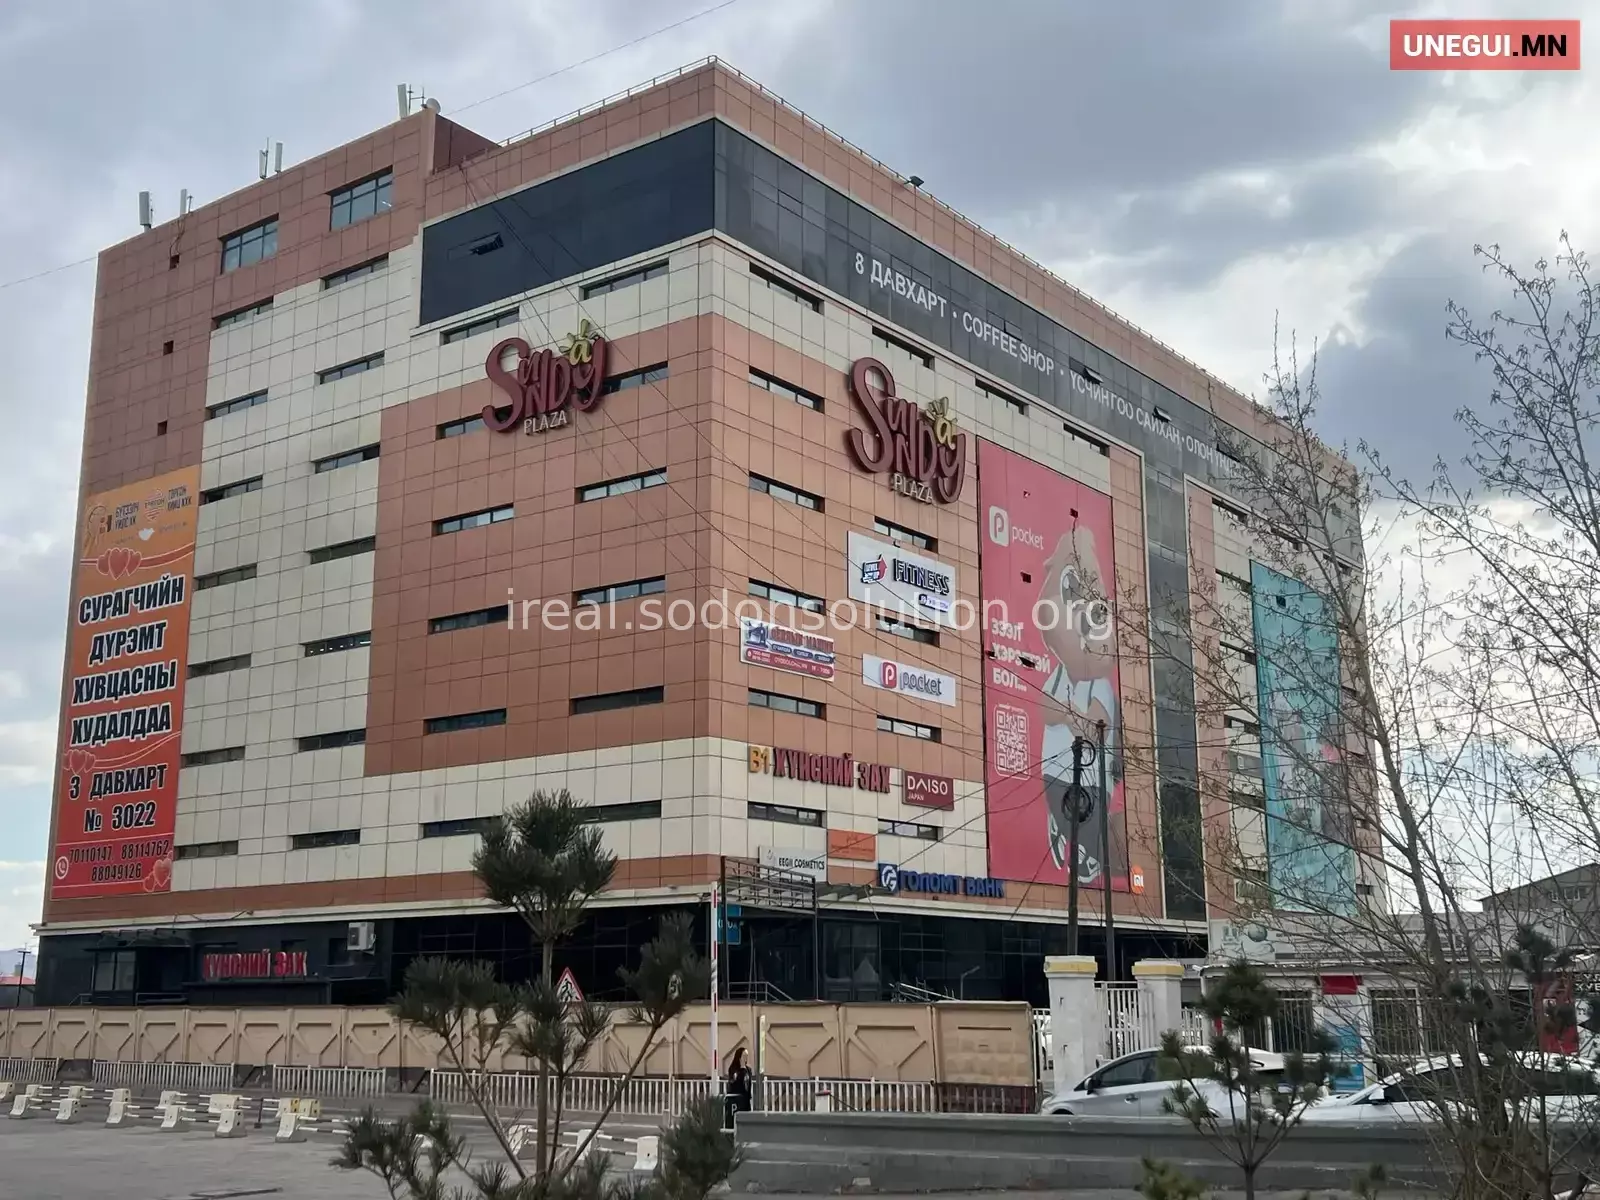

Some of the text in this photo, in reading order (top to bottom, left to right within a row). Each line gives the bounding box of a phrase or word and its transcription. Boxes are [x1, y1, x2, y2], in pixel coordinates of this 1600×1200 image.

[855, 252, 865, 275] 8
[870, 259, 947, 318] ДАВХАРТ
[963, 311, 1018, 358] COFFEE
[1019, 340, 1055, 376] SHOP
[523, 410, 568, 435] PLAZA
[893, 472, 934, 502] PLAZA
[1012, 525, 1044, 550] pocket
[893, 558, 950, 596] FITNESS
[79, 575, 185, 625] СУРАГЧИЙН
[89, 621, 167, 667] ДҮРЭМТ
[72, 660, 177, 705] ХУВЦАСНЫ
[900, 671, 942, 697] pocket
[71, 703, 172, 747] ХУДАЛДАА
[70, 764, 168, 801] 3 ДАВХАРТ
[857, 761, 891, 794] ЗАХ
[907, 775, 948, 796] DAISO
[907, 791, 925, 801] JAPAN
[84, 801, 156, 832] № 3022
[121, 839, 169, 859] 88114762
[794, 858, 825, 870] COSMETICS
[91, 862, 142, 881] 88049126
